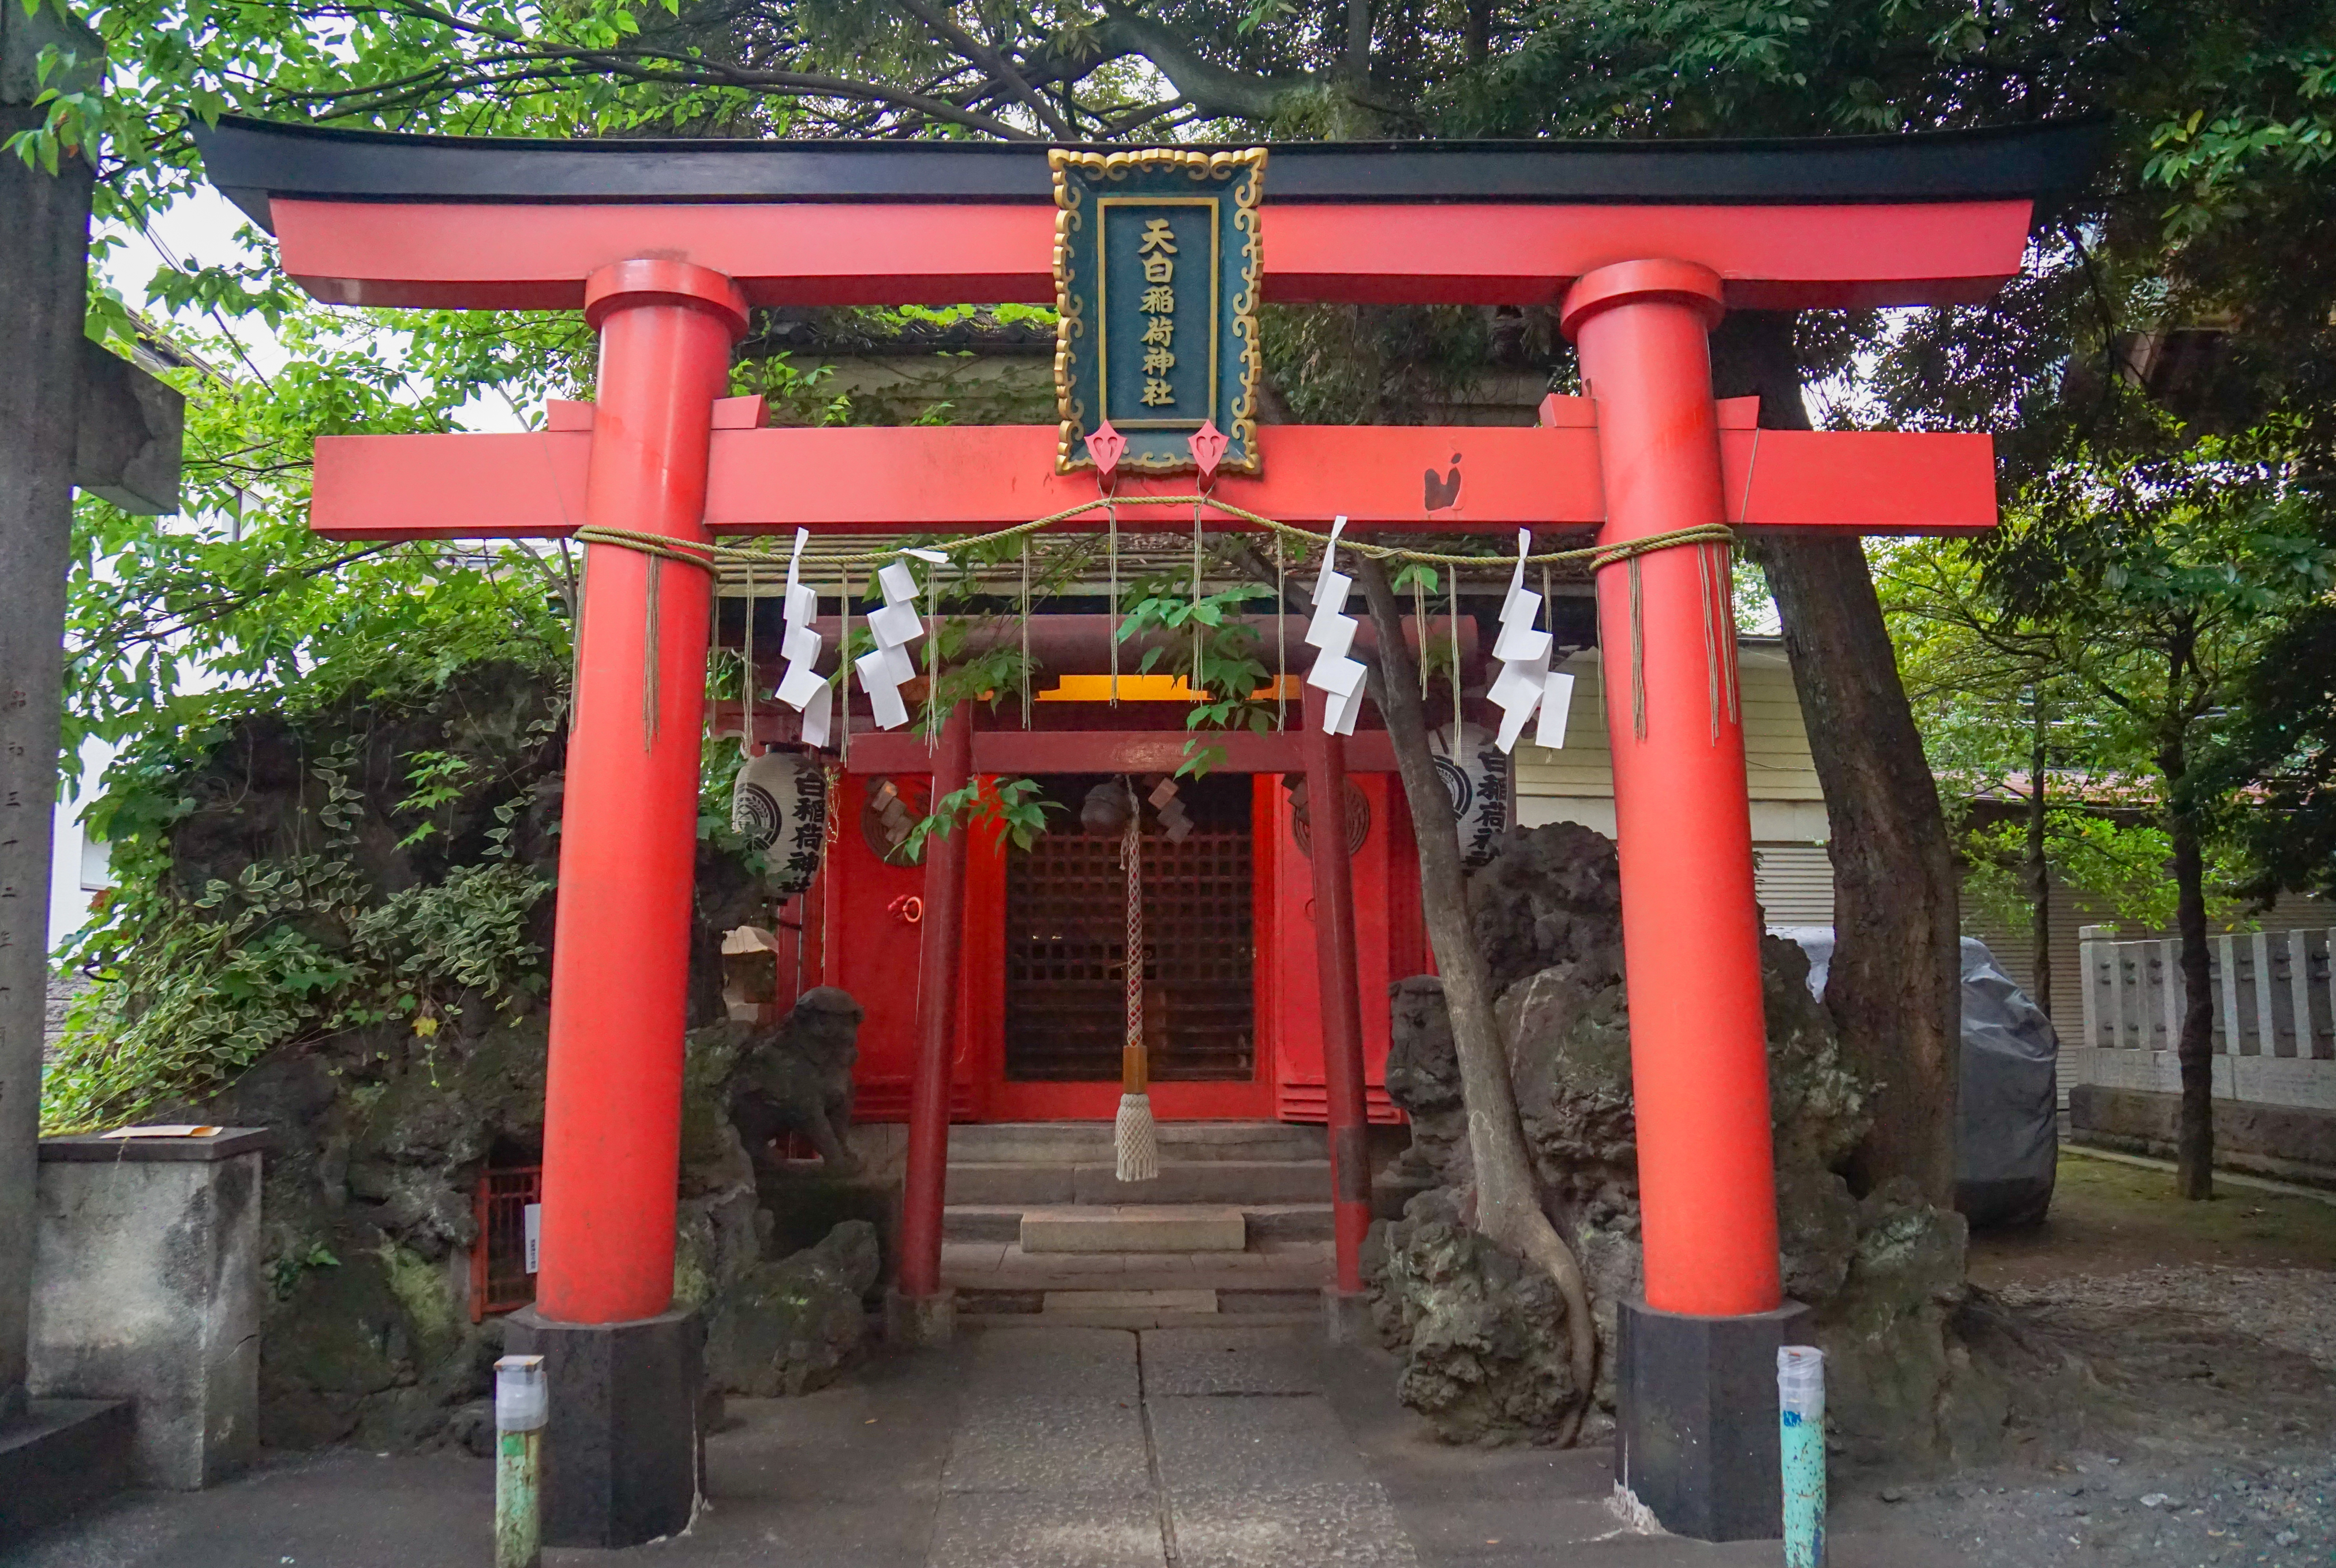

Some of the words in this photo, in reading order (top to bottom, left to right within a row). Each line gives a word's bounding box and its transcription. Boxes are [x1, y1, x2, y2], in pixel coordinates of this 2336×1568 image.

[1138, 218, 1178, 407] 天白稲荷神社
